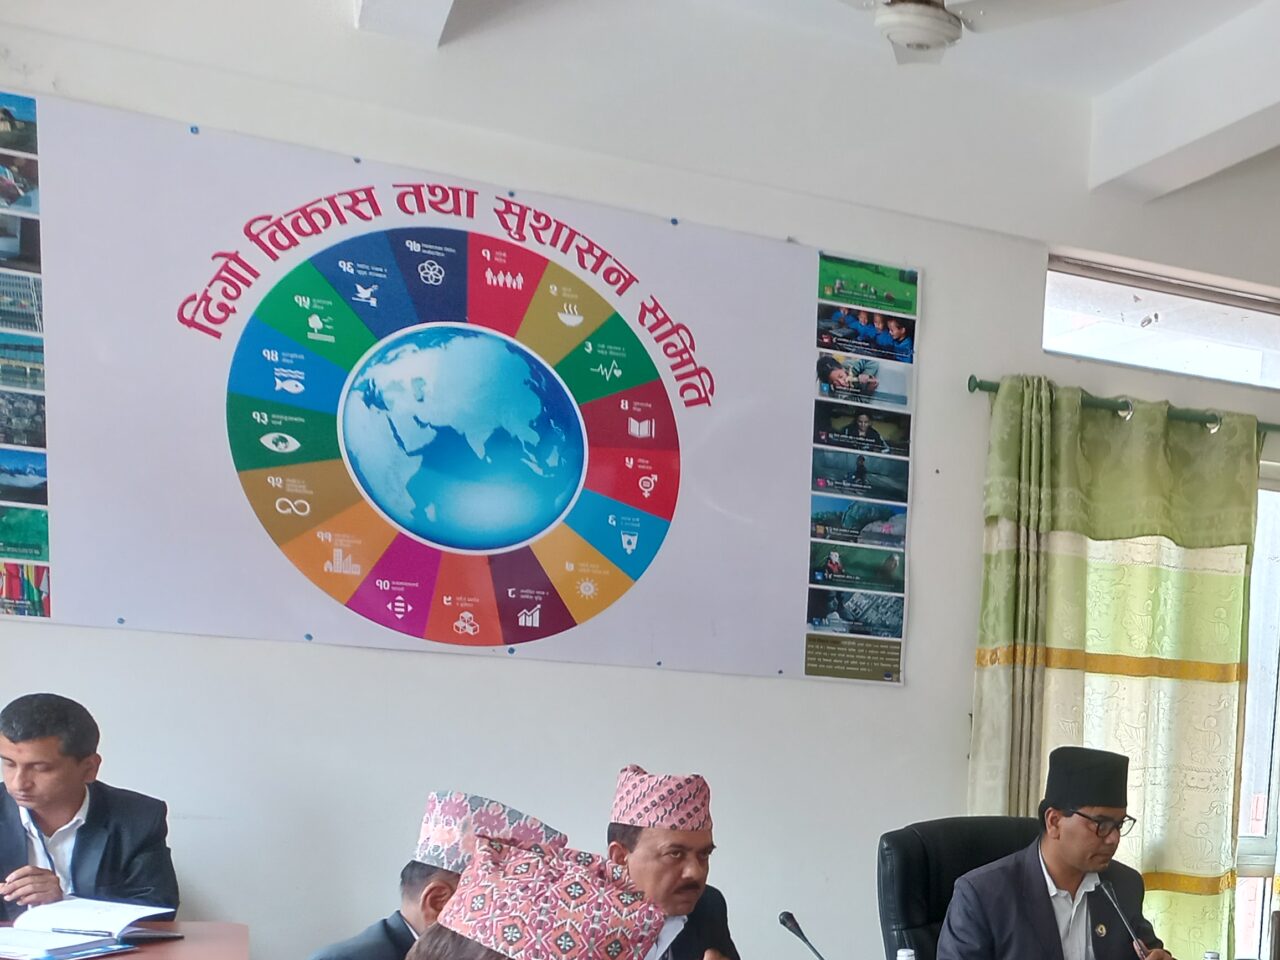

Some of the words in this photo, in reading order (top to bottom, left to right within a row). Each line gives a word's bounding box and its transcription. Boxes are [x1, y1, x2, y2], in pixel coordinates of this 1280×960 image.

[177, 249, 261, 340] दिगो
[243, 185, 382, 264] विकास
[393, 183, 479, 219] तथा
[494, 195, 639, 297] सुशासन
[637, 295, 715, 408] समिति
